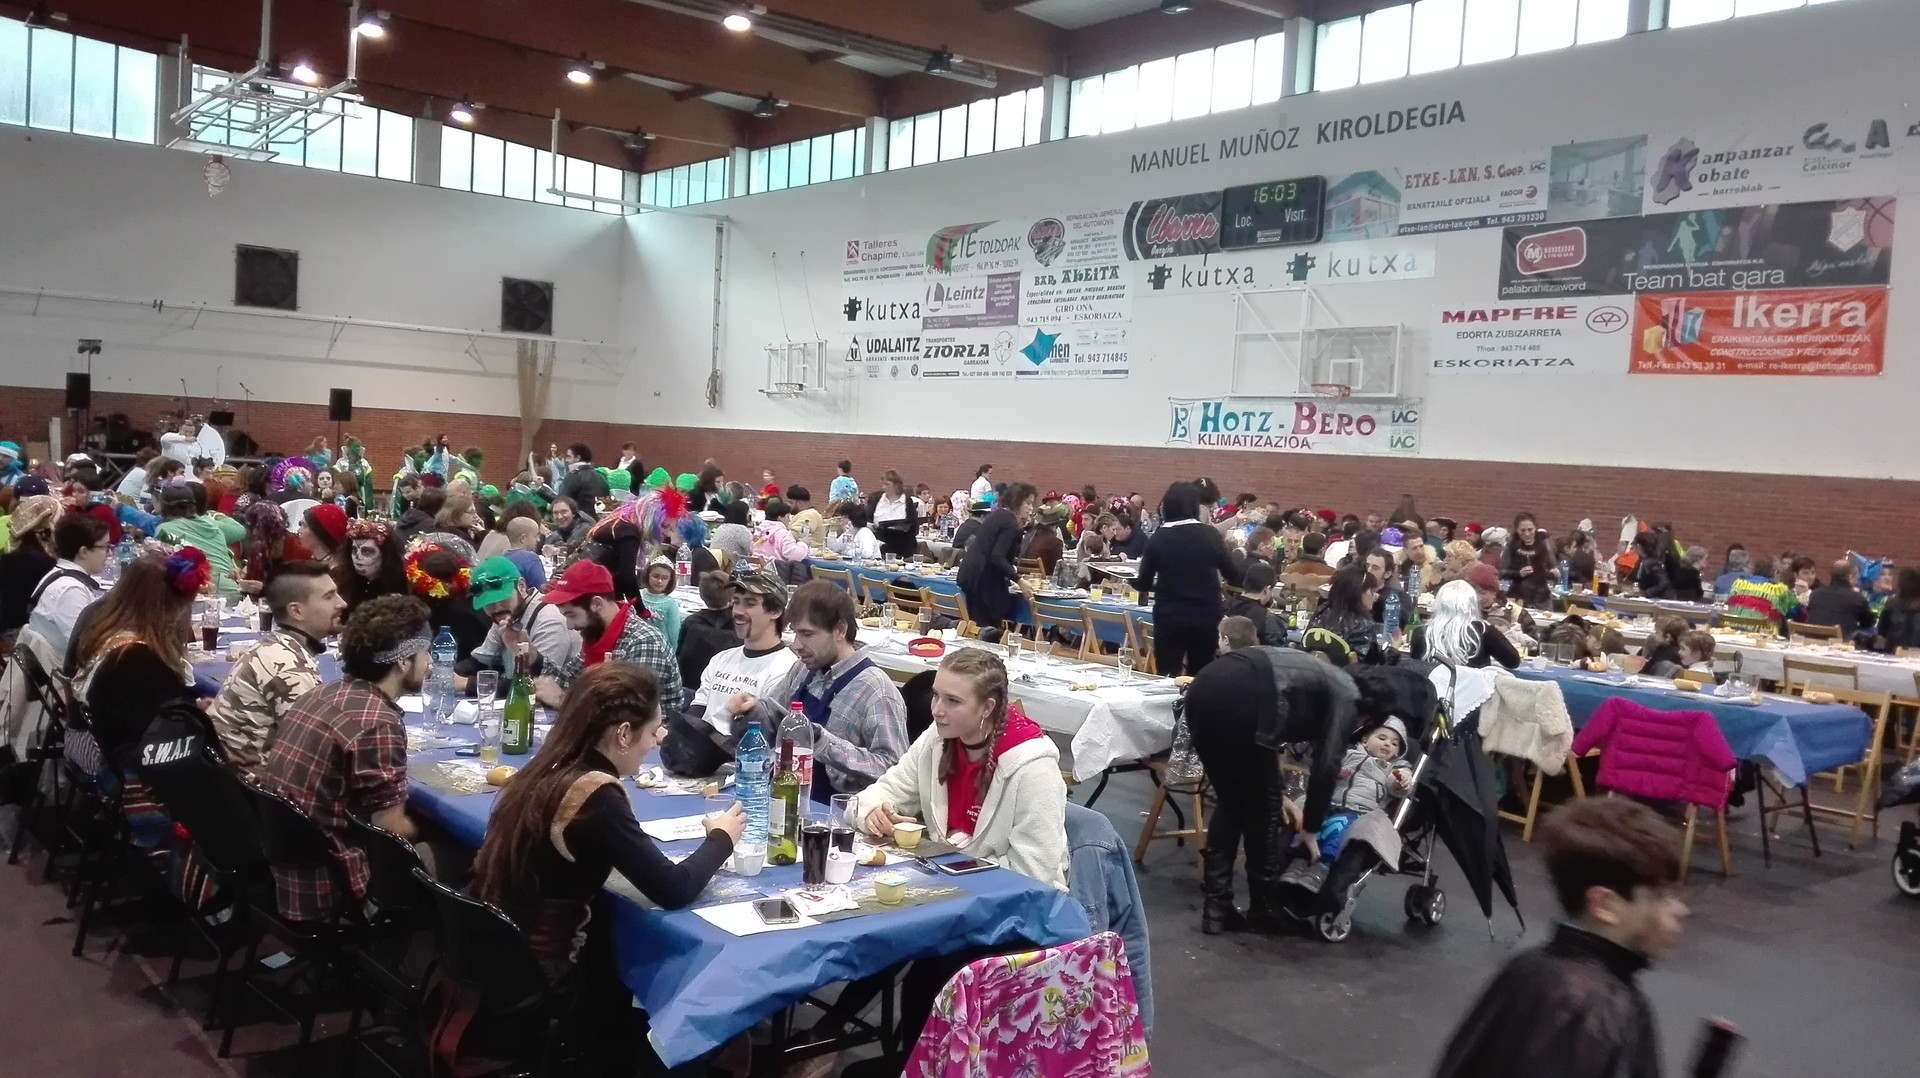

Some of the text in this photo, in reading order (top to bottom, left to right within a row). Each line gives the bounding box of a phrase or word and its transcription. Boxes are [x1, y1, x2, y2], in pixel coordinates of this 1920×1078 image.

[1130, 100, 1466, 174] MANUEL MUÑOZ KIROLDEGIA
[1404, 170, 1440, 190] ETXE
[1254, 182, 1296, 203] 16:03
[1500, 188, 1523, 197] FAGOR
[1406, 199, 1453, 211] BANATZAILE
[1454, 195, 1491, 207] OFIZIALA
[864, 240, 898, 250] Talleres
[980, 236, 1021, 254] TOLDOAK
[1328, 251, 1418, 278] kutxa
[1034, 275, 1056, 286] BAR
[1182, 264, 1254, 288] kutxa
[1623, 269, 1785, 290] Team bat gara
[945, 286, 985, 301] Leintz
[1502, 282, 1586, 296] palabrahitzaword
[866, 298, 920, 321] kutxa
[1074, 312, 1122, 321] ESKORIATZA
[1442, 305, 1578, 324] MAPFRE
[1732, 295, 1866, 328] Ikerra
[1457, 328, 1562, 340] EDORTA ZUBIZARRETA
[867, 337, 920, 353] UDALAITZ
[923, 344, 990, 358] ZIORLA
[1074, 353, 1127, 363] Tel. 943 714845
[1434, 358, 1575, 368] ESKORIATZA
[1198, 434, 1311, 450] KLIMATIZAZIOA
[142, 736, 196, 766] S.W.A.T.
